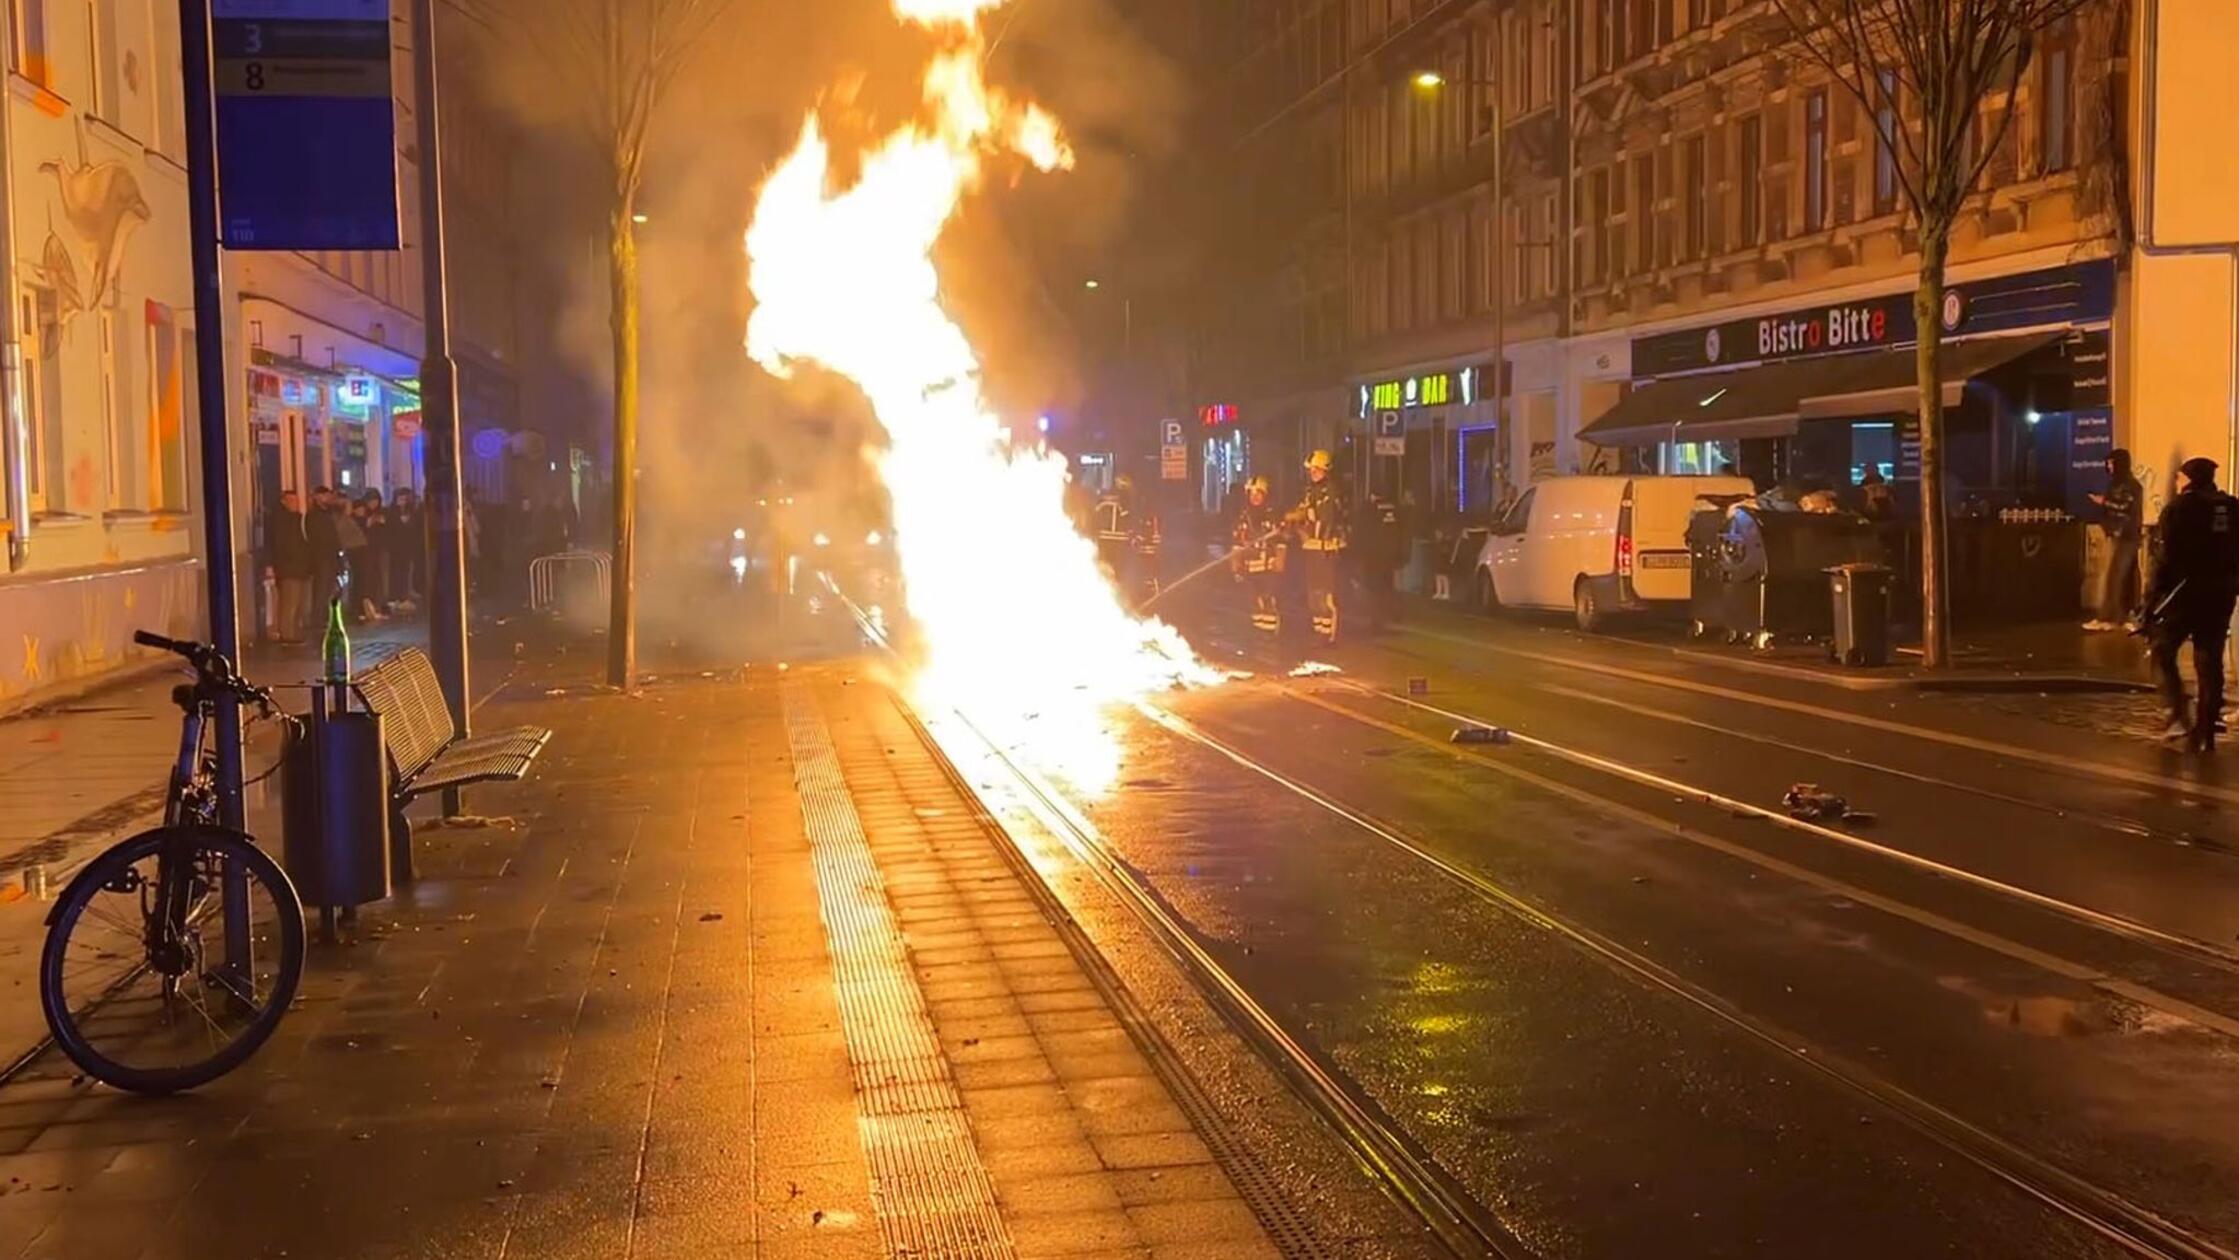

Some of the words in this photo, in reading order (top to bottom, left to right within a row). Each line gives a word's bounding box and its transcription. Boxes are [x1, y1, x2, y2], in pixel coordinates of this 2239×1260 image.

[244, 24, 262, 53] 3
[245, 62, 264, 91] 8
[1758, 319, 1821, 355] Bistro
[1828, 308, 1885, 346] Bitte
[1422, 374, 1448, 405] BAR
[1166, 422, 1182, 443] P
[1382, 411, 1399, 434] P
